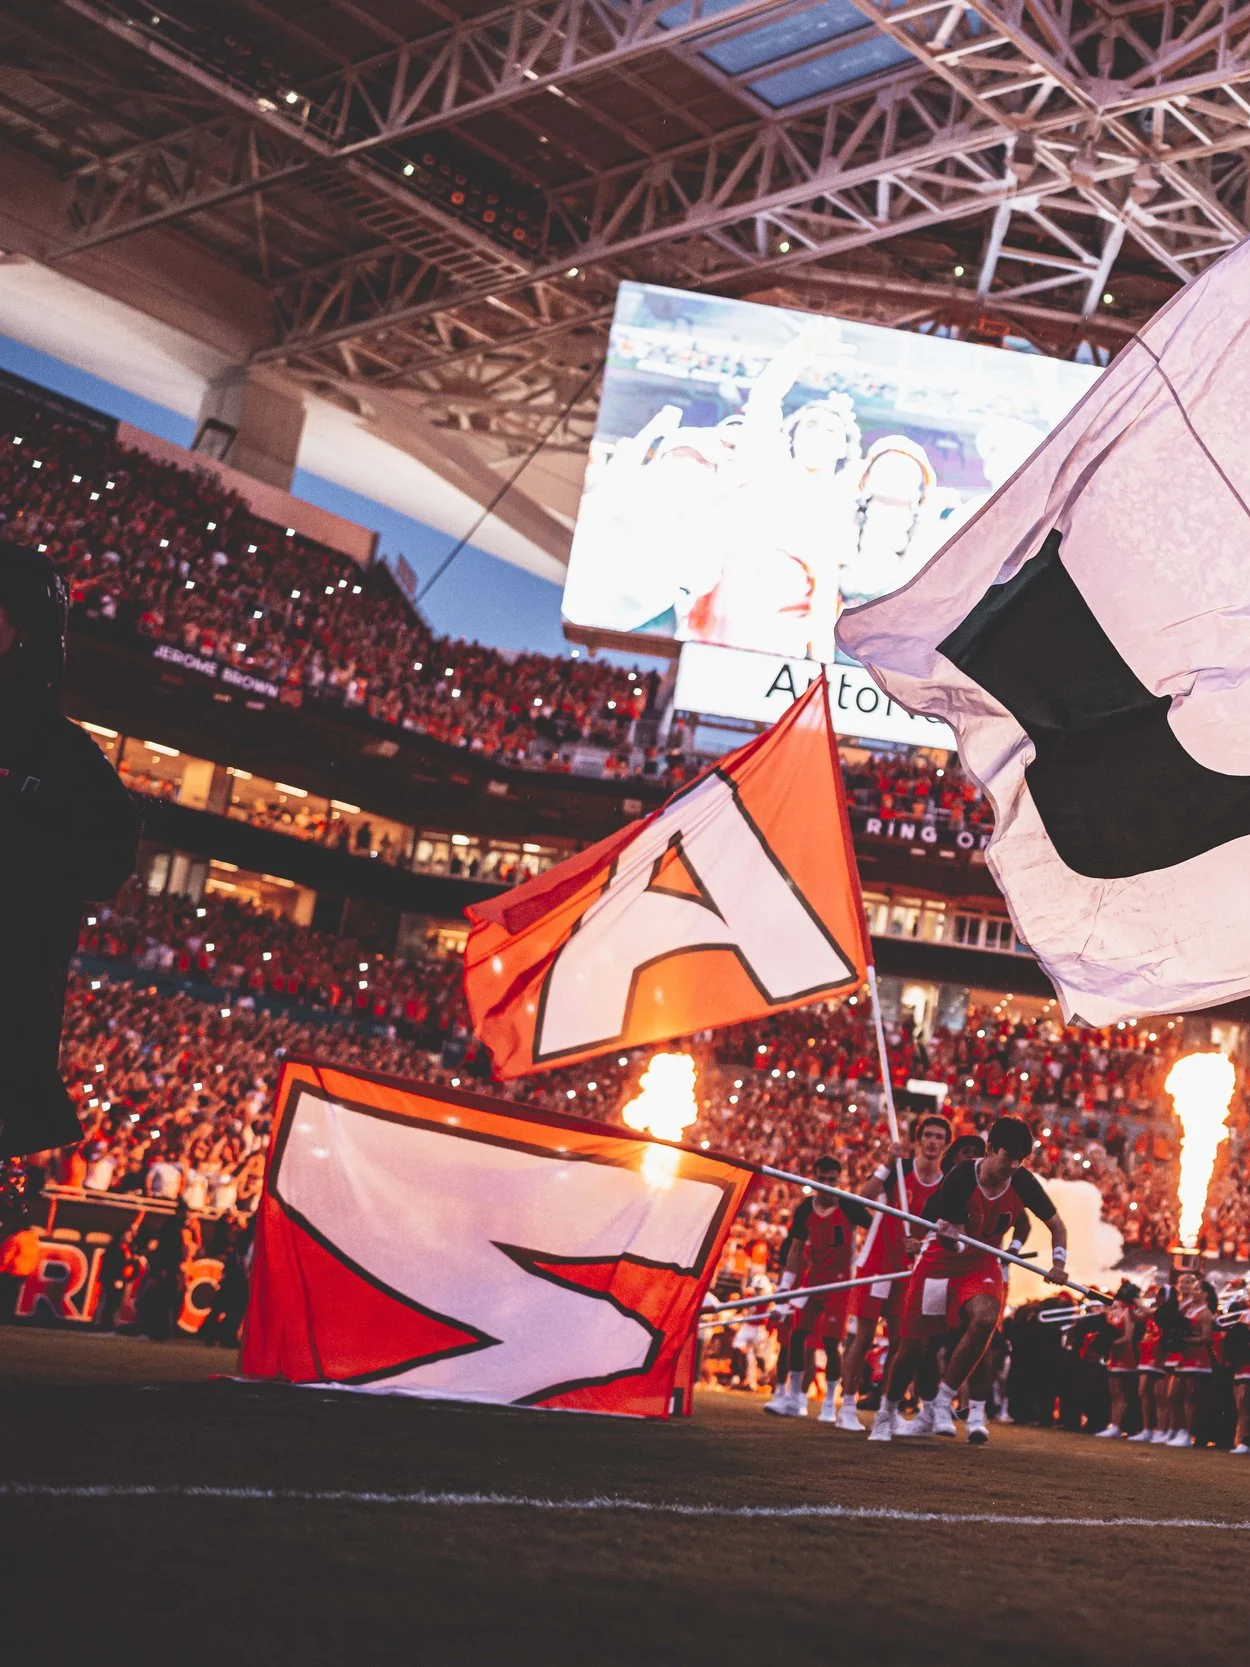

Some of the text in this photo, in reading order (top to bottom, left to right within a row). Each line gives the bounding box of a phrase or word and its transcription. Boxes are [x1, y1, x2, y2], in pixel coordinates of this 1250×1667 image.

[154, 645, 218, 677] JEROME
[221, 667, 279, 698] BROWN
[866, 817, 938, 844] RING
[533, 766, 860, 1064] A
